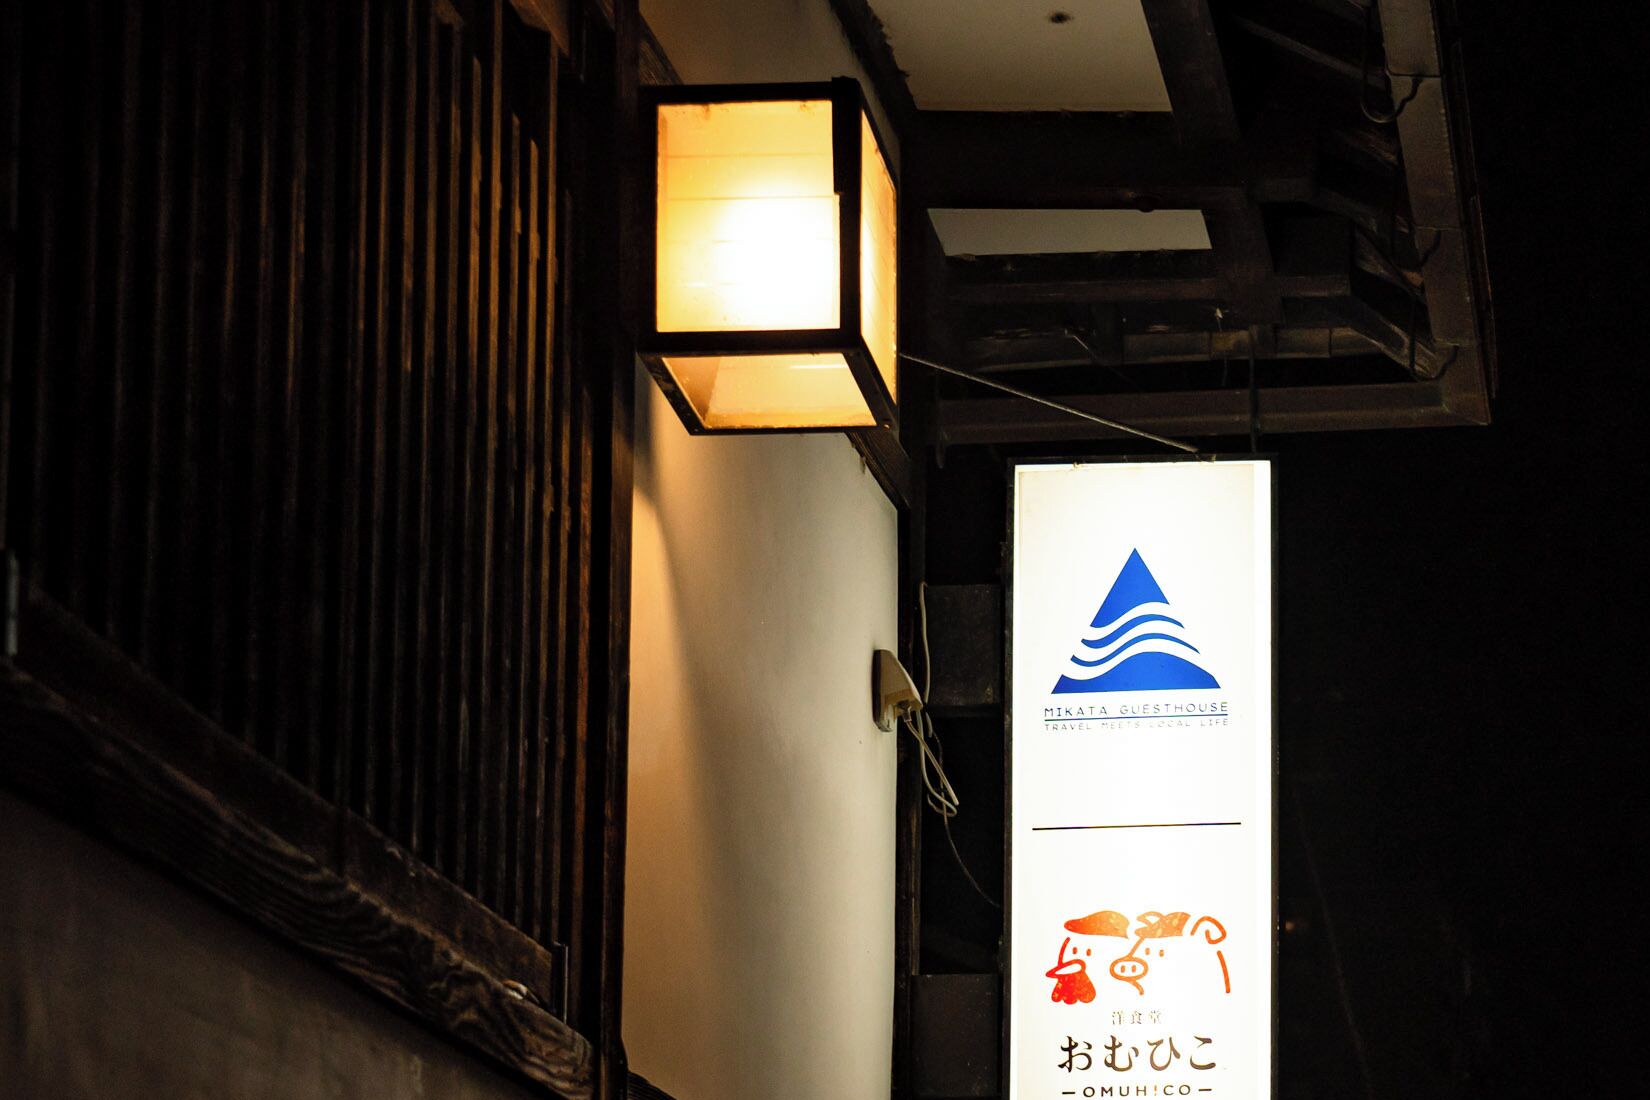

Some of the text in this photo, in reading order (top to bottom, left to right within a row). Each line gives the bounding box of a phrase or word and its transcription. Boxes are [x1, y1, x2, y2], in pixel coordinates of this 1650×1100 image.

[1044, 702, 1229, 717] MIKATA GUESTHOUSE
[1044, 722, 1092, 732] TRAVEL
[1200, 718, 1229, 727] LIFE
[1057, 1034, 1217, 1073] おむひこ
